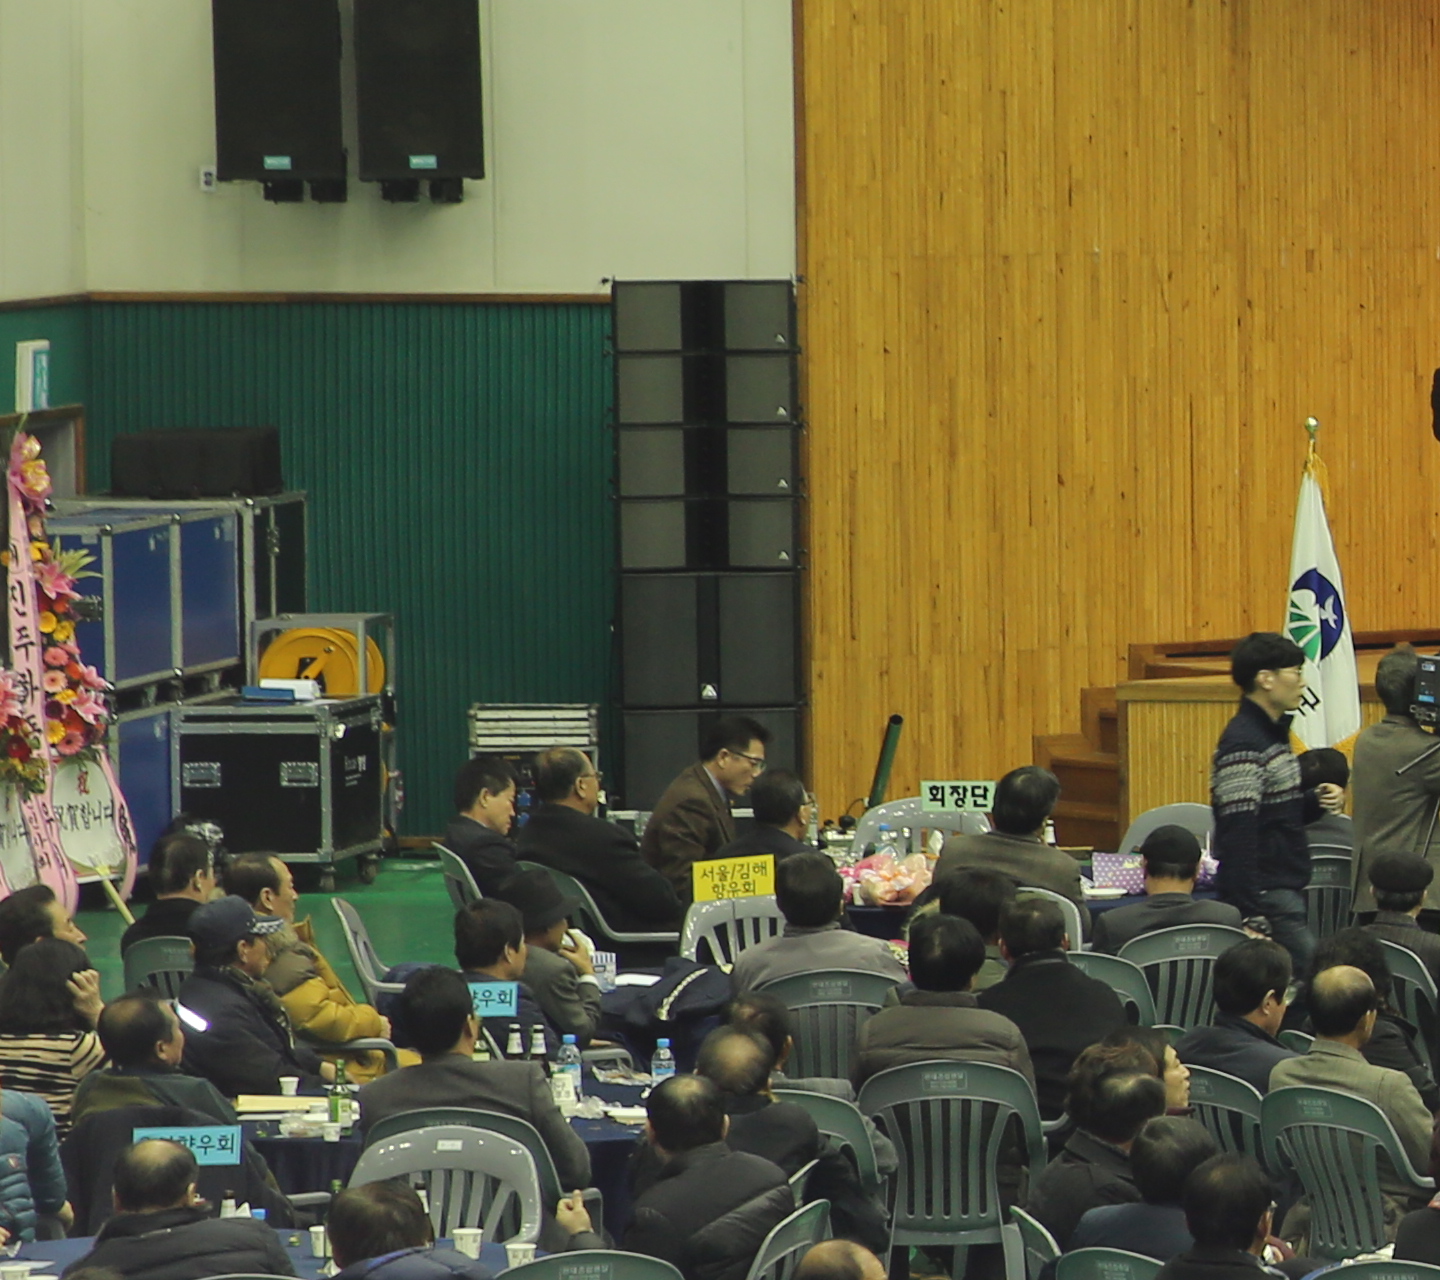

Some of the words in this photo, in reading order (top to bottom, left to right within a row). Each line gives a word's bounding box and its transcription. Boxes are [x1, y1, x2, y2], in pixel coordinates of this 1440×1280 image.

[929, 783, 991, 810] 회장단
[699, 861, 769, 882] 서울/김해
[711, 880, 757, 898] 향우회
